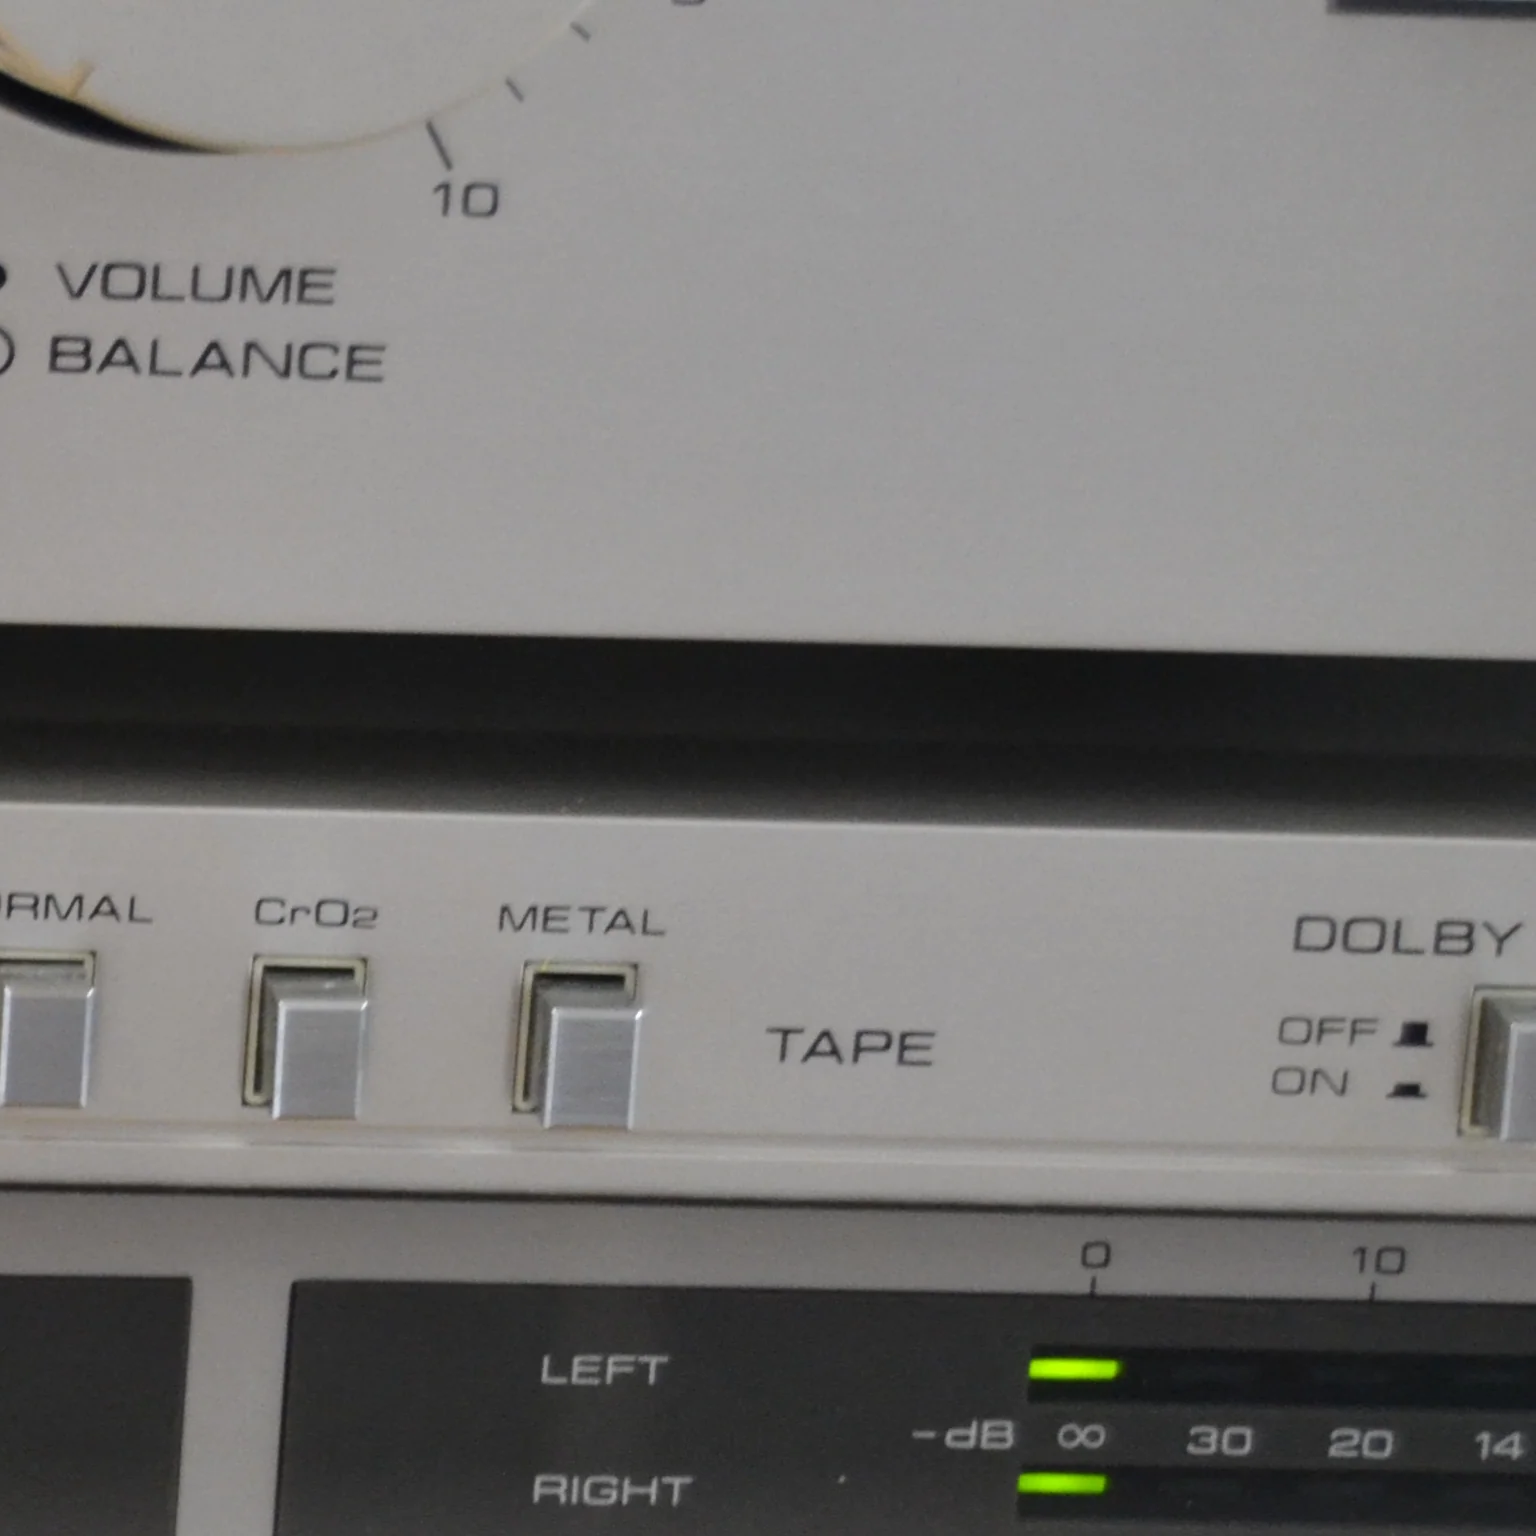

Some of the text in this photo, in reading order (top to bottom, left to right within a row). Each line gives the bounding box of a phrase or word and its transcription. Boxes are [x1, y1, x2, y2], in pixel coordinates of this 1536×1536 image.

[433, 181, 500, 218] 10
[56, 261, 335, 305] VOLUME
[48, 335, 385, 382] BALANCE
[498, 904, 665, 937] METAL
[1293, 914, 1523, 957] DOLBY
[767, 1027, 935, 1067] TAPE
[1277, 1016, 1378, 1046] OFF
[1271, 1066, 1349, 1097] ON
[1080, 1240, 1112, 1269] 0
[1352, 1245, 1407, 1276] 10
[541, 1354, 669, 1386] LEFT
[1186, 1425, 1254, 1456] 30
[1328, 1427, 1394, 1460] 20
[1476, 1431, 1524, 1460] 14
[532, 1474, 693, 1506] RIGHT
